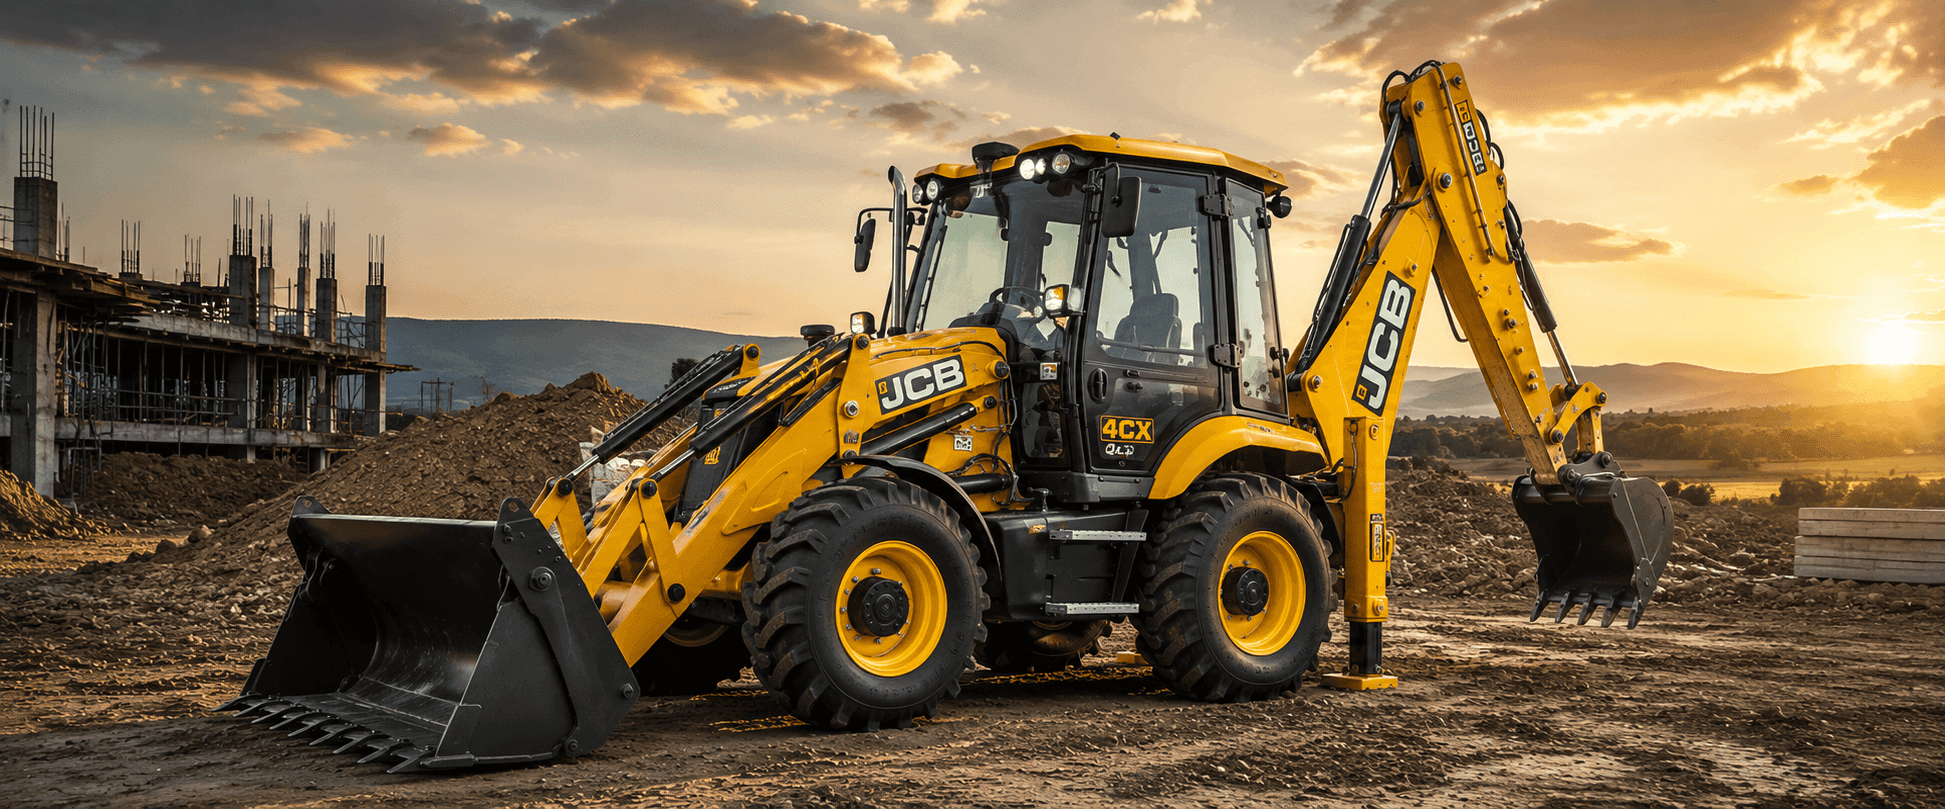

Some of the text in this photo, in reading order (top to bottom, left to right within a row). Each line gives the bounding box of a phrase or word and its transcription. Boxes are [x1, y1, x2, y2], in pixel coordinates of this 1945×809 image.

[1361, 279, 1411, 410] JCB
[881, 359, 964, 409] JCB
[1102, 418, 1152, 441] 4CX
